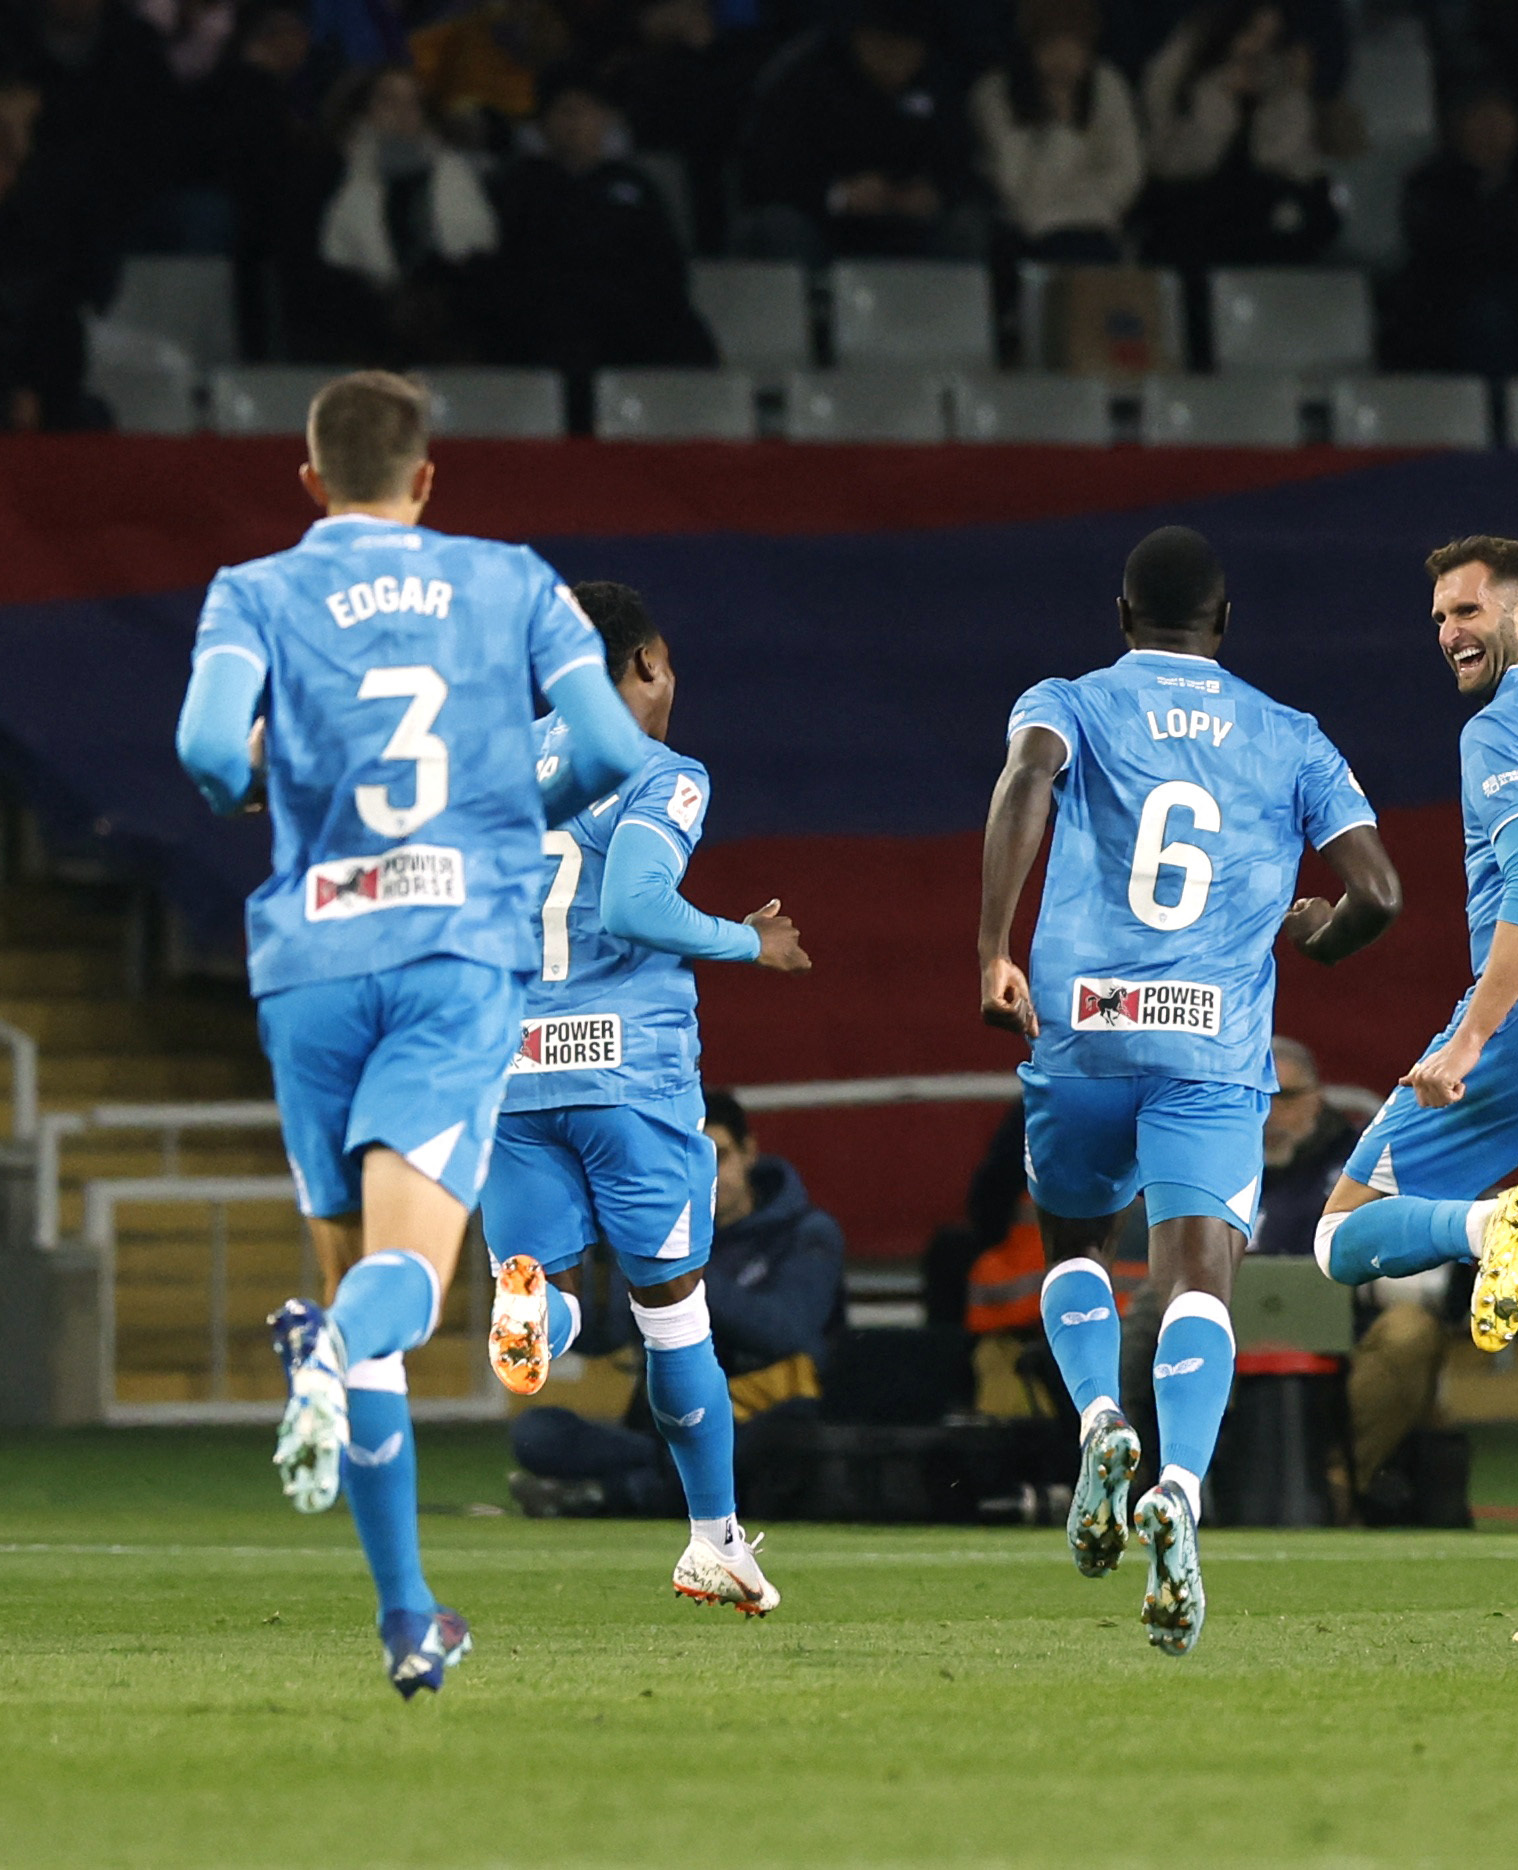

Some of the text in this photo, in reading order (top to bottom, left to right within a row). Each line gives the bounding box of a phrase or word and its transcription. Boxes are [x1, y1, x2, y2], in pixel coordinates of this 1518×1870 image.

[325, 575, 453, 629] EDGAR
[1146, 708, 1234, 748] LOPY
[354, 664, 449, 839] 3
[1128, 780, 1222, 931] 6
[541, 830, 583, 982] 7
[1143, 985, 1215, 1009] POWER
[545, 1019, 615, 1043] POWER
[1142, 1005, 1214, 1030] HORSE
[545, 1041, 616, 1065] HORSE
